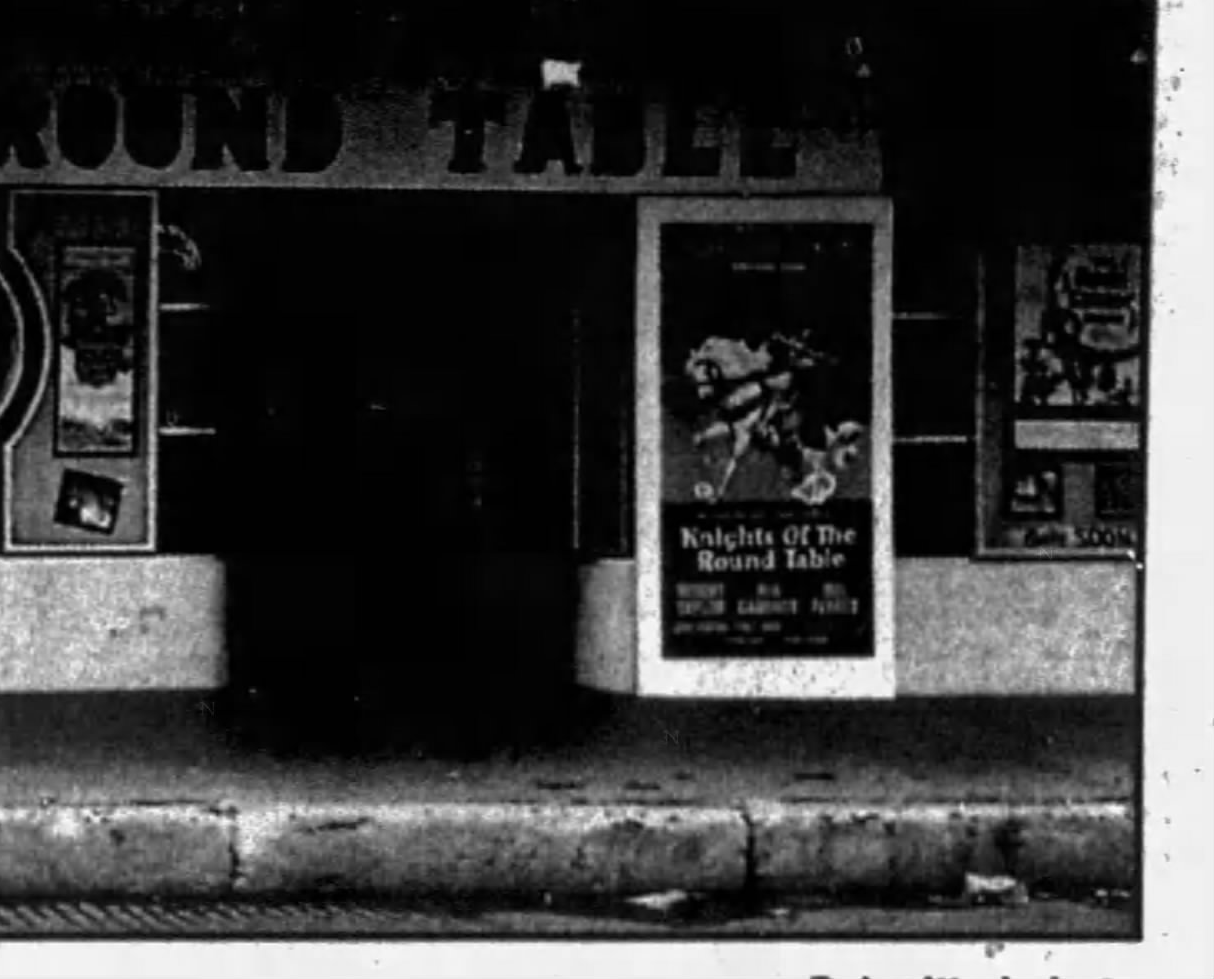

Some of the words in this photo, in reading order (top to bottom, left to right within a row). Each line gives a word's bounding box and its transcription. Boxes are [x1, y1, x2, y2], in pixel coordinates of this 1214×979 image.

[679, 526, 774, 552] Knights
[782, 525, 812, 546] Of
[816, 524, 857, 547] The
[697, 548, 776, 572] Round
[785, 547, 846, 570] Table
